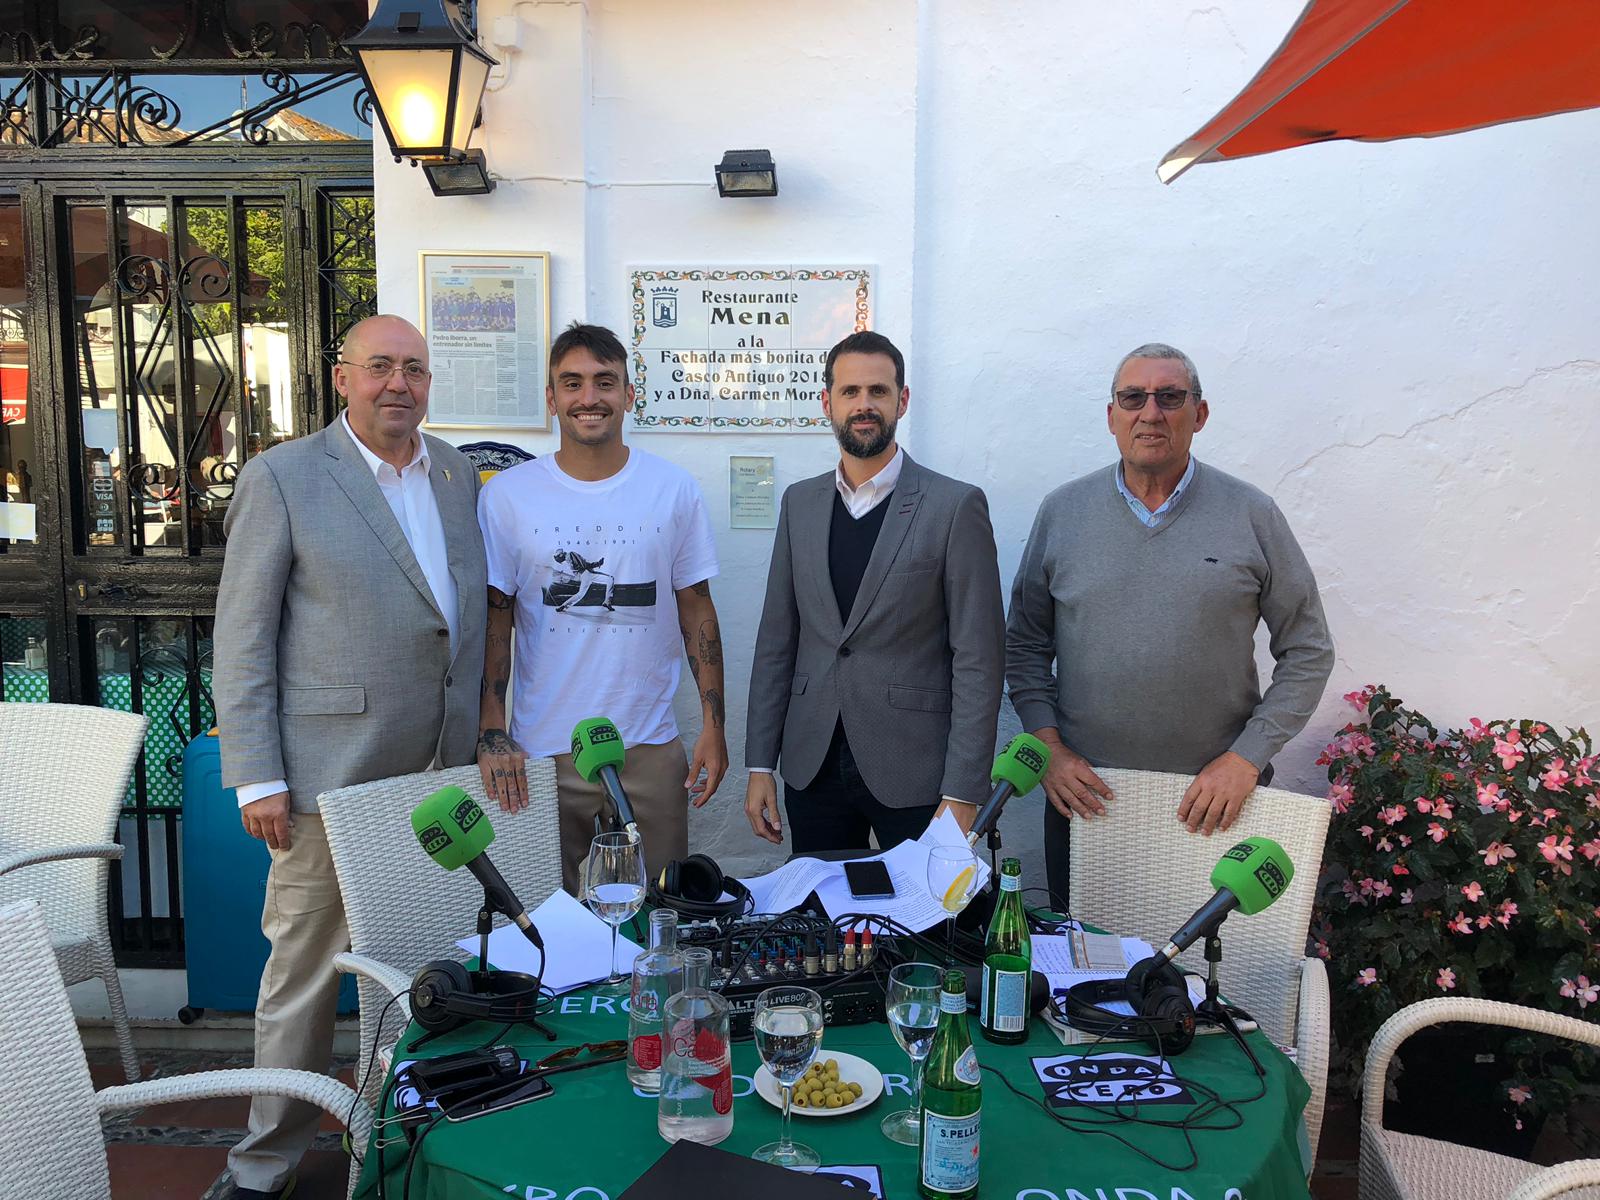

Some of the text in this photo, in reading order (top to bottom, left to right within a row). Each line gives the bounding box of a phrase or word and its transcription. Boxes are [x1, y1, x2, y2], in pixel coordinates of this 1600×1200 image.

[701, 290, 798, 304] Restaurante
[710, 307, 790, 325] Mena
[737, 335, 764, 348] a la
[661, 350, 726, 364] Fachada
[731, 350, 761, 364] más
[767, 350, 814, 364] bonita
[671, 370, 720, 383] Casco
[725, 370, 785, 385] Antiguo
[654, 390, 662, 402] y
[667, 391, 676, 401] a
[680, 388, 714, 401] Dña.
[719, 387, 780, 401] Carmen
[534, 525, 661, 534] FREDDIE
[1054, 1064, 1153, 1077] ONDA
[1073, 1084, 1165, 1097] CERO
